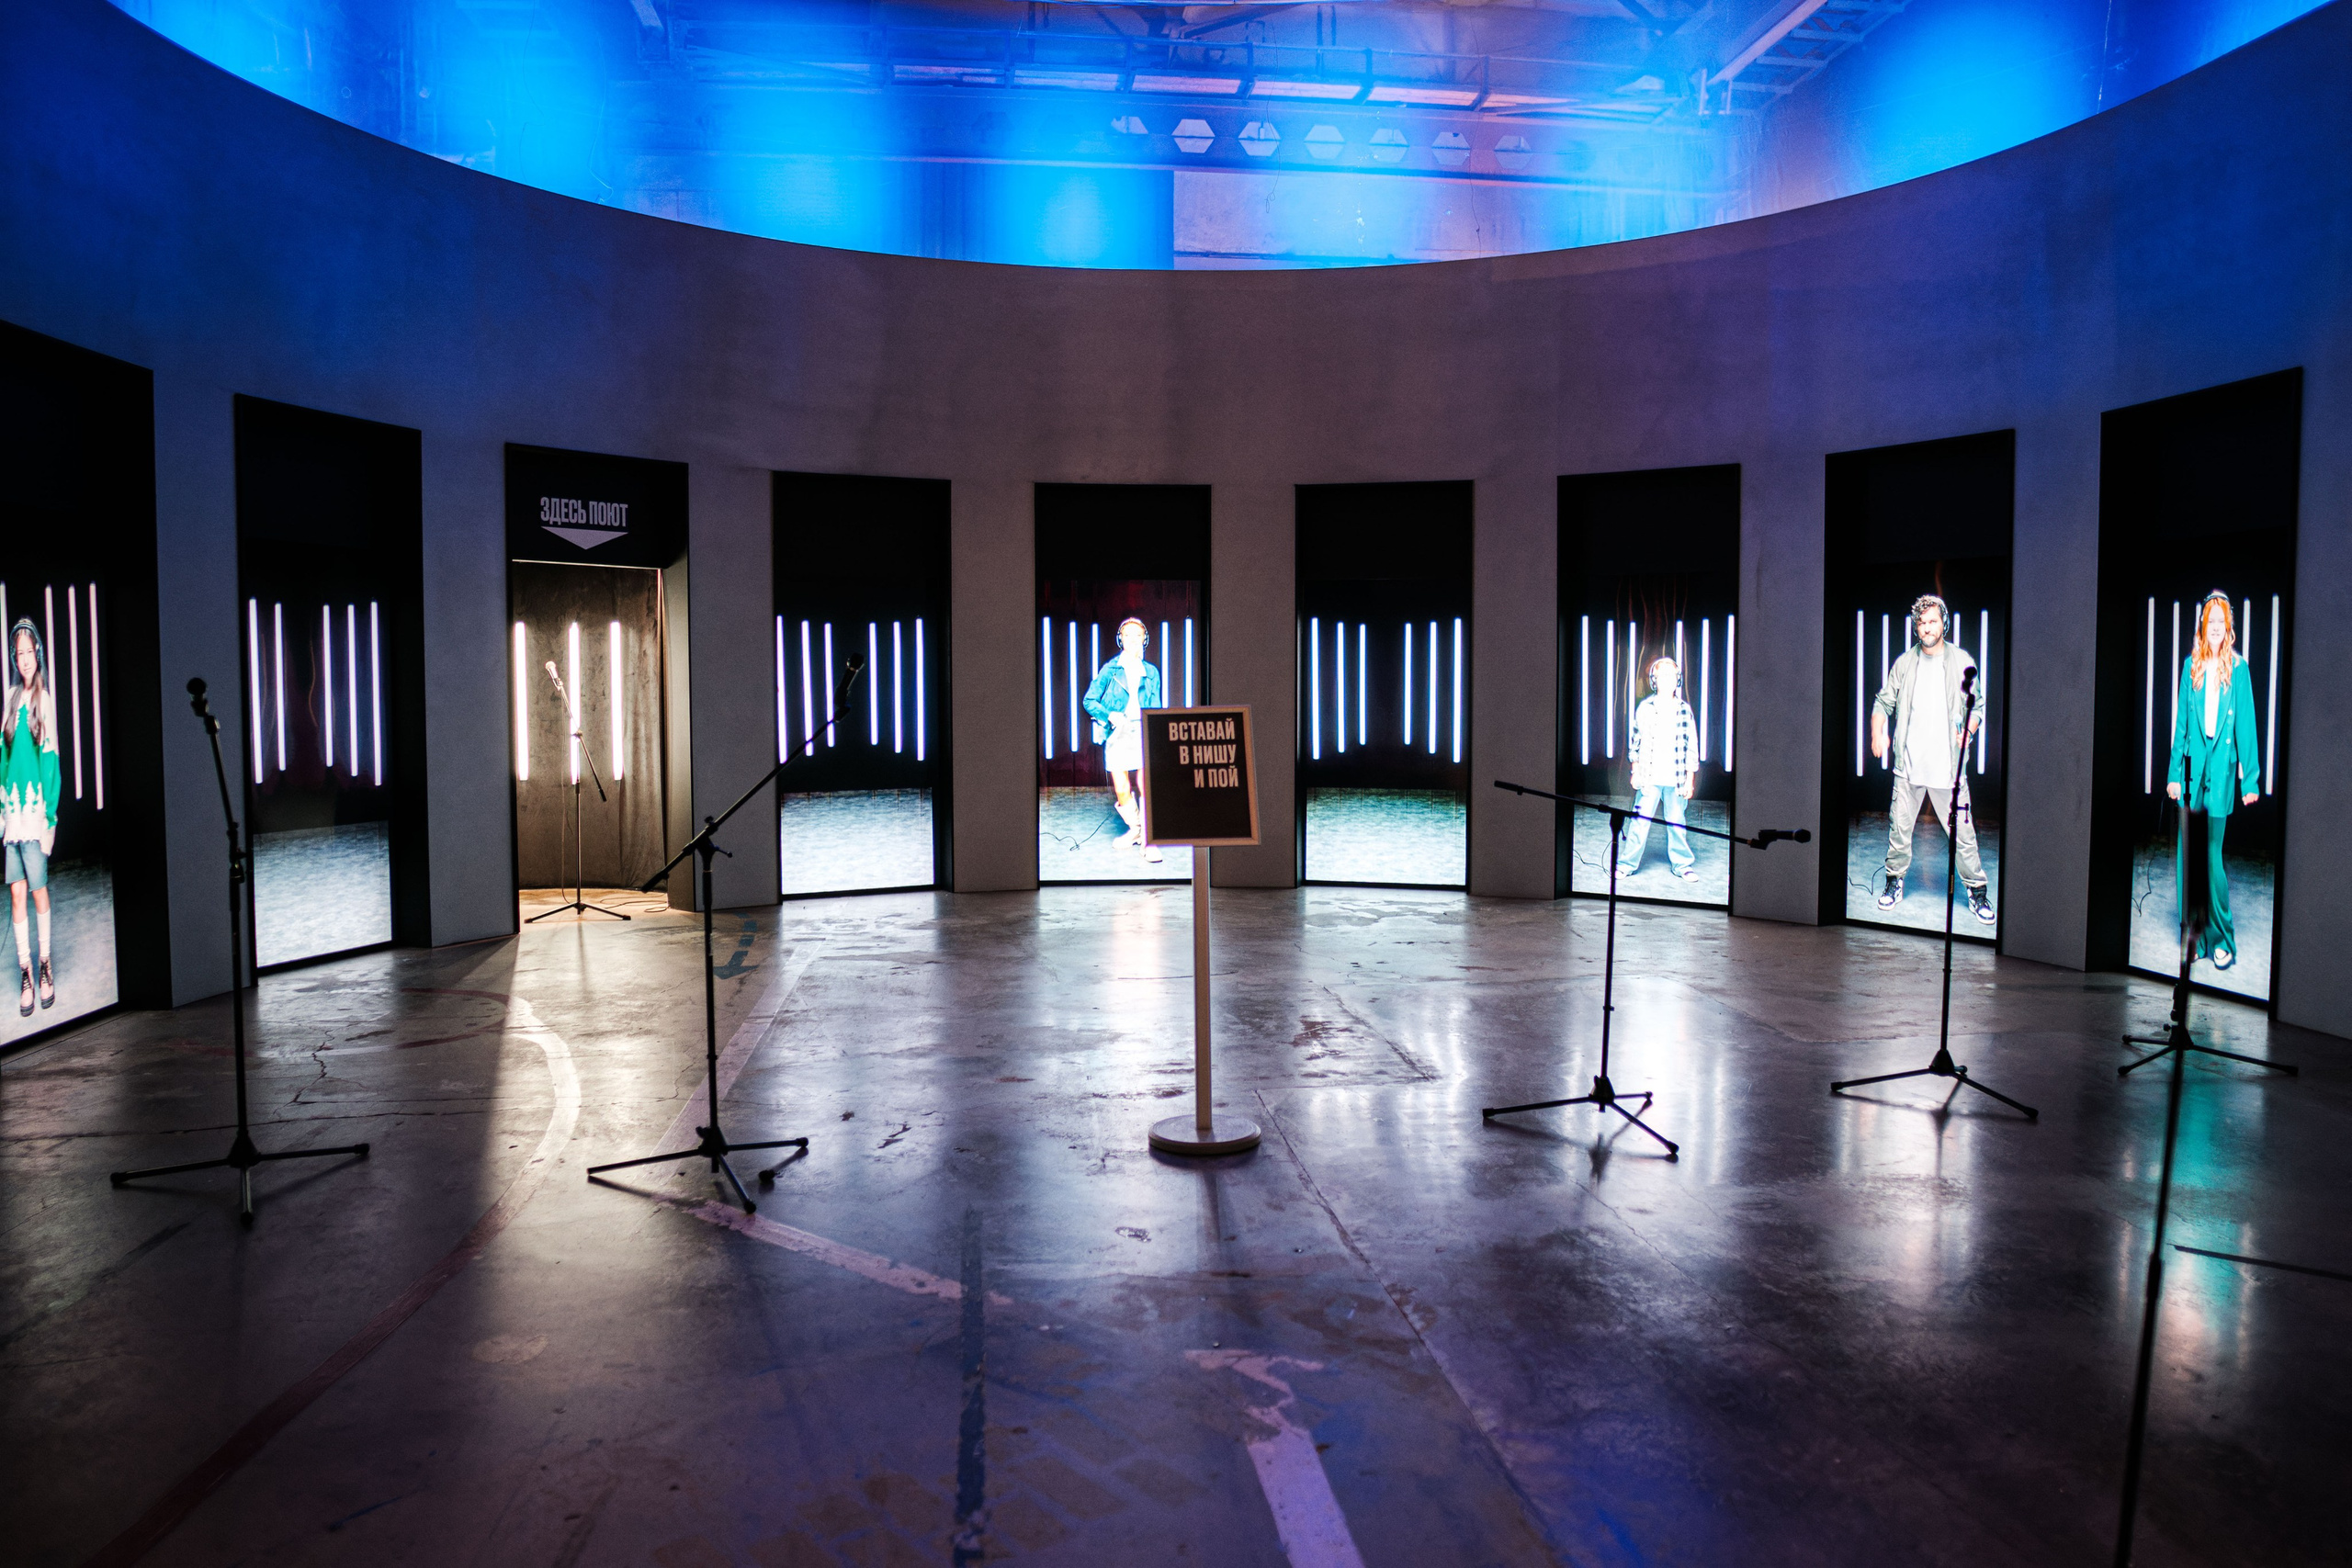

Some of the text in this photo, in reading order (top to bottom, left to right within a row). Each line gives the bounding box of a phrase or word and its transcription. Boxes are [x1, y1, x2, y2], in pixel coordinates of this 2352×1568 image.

[540, 496, 628, 527] ЗДЕСЬ ПОЮТ
[1169, 717, 1236, 741] ВСТАВАЙ
[1179, 744, 1237, 765] В НИШУ
[1193, 765, 1239, 788] И ПОЙ
